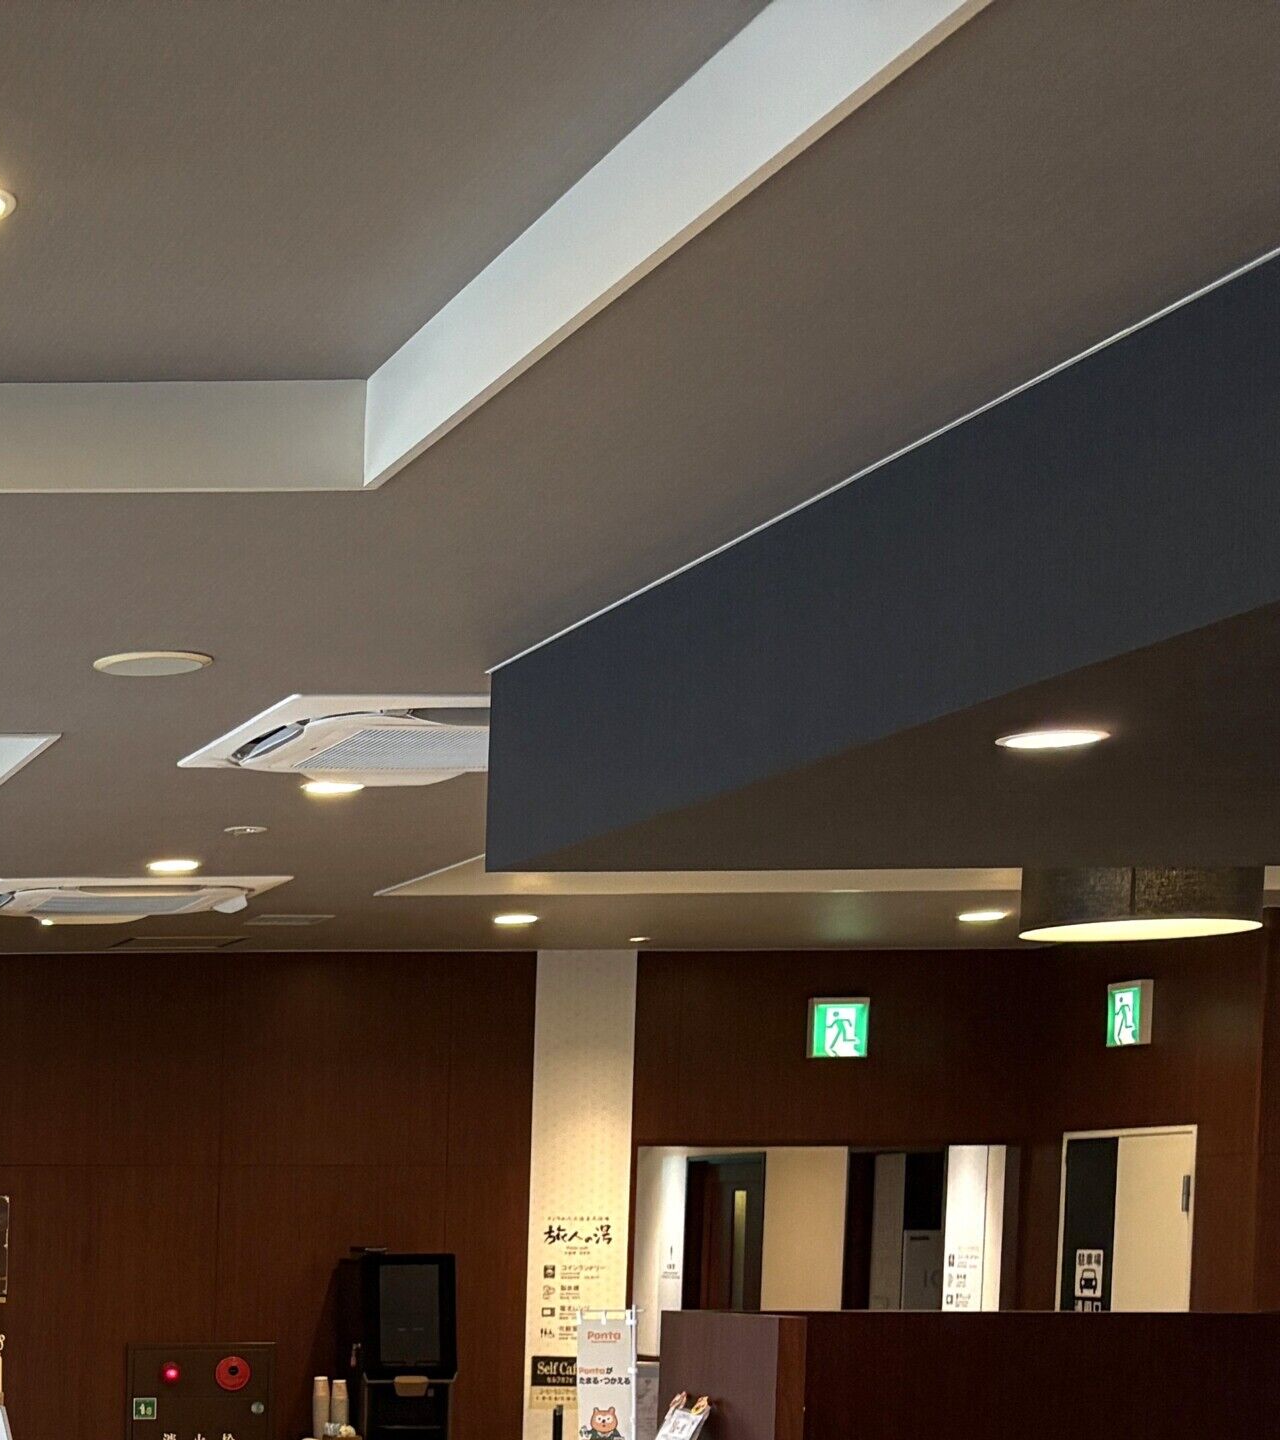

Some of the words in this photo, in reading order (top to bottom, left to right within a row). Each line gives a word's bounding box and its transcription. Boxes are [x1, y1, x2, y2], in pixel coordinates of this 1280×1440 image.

[543, 1225, 612, 1245] 旅人の湯
[537, 1361, 558, 1375] Self
[559, 1361, 577, 1376] Caf
[579, 1376, 631, 1385] たまる・つかえる
